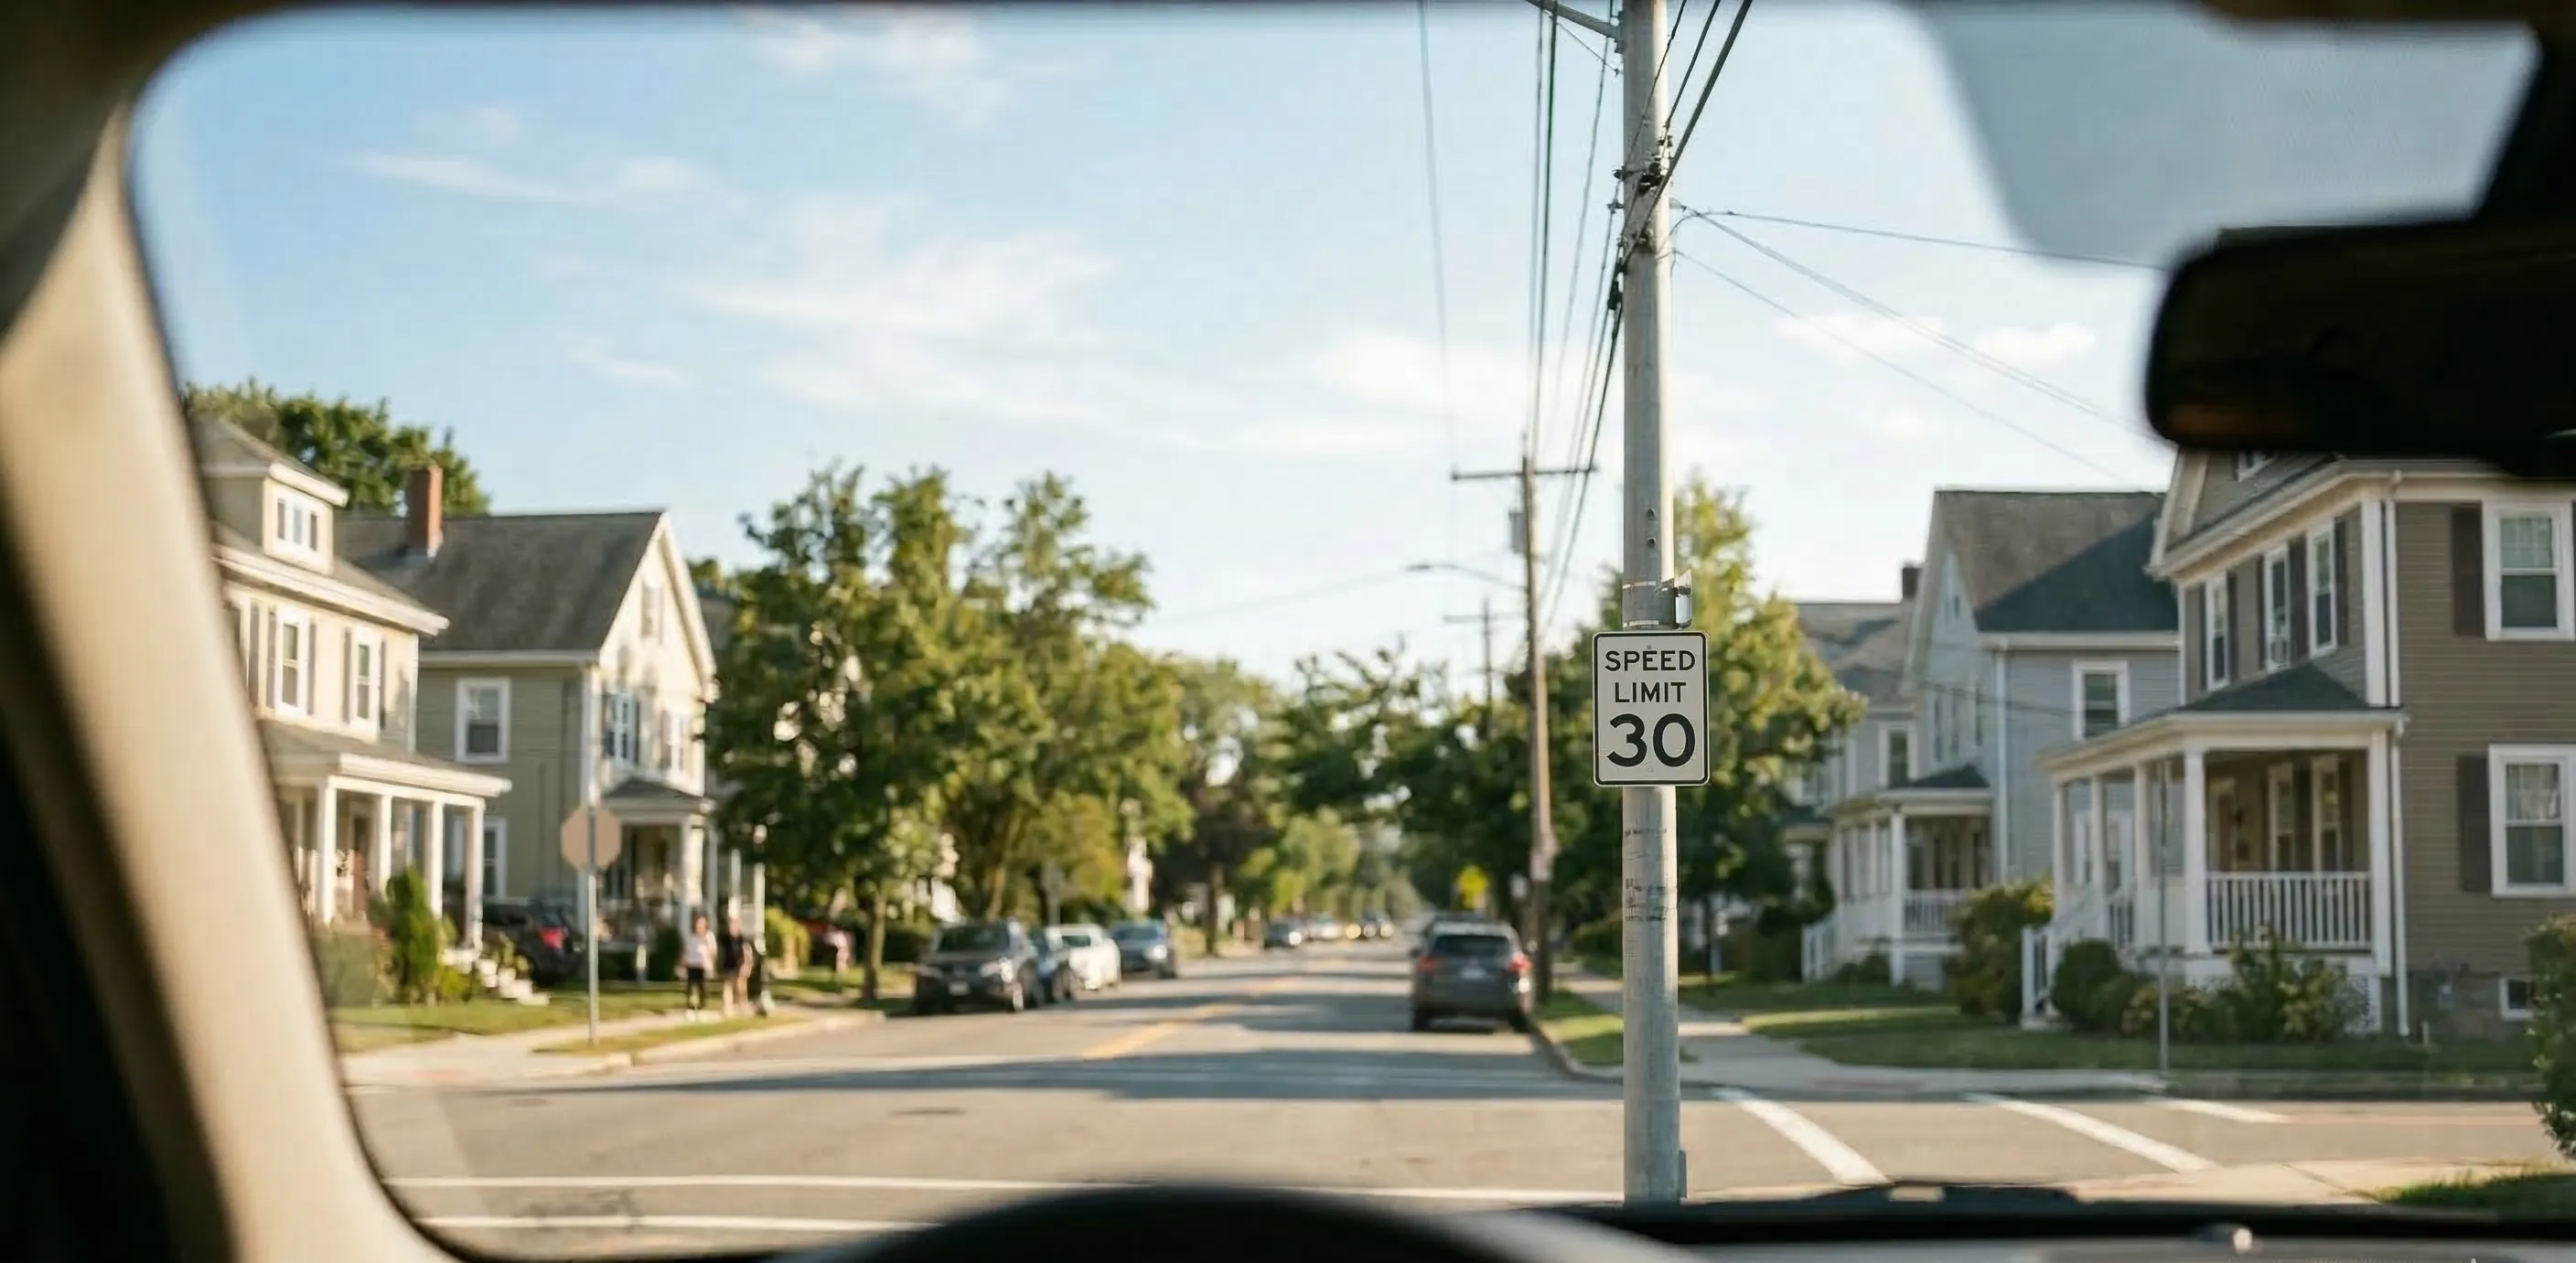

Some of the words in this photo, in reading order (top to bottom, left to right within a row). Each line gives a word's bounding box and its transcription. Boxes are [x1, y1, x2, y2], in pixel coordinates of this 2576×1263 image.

[1605, 650, 1696, 671] SPEED
[1615, 681, 1687, 703] LIMIT
[1606, 713, 1696, 767] 30
